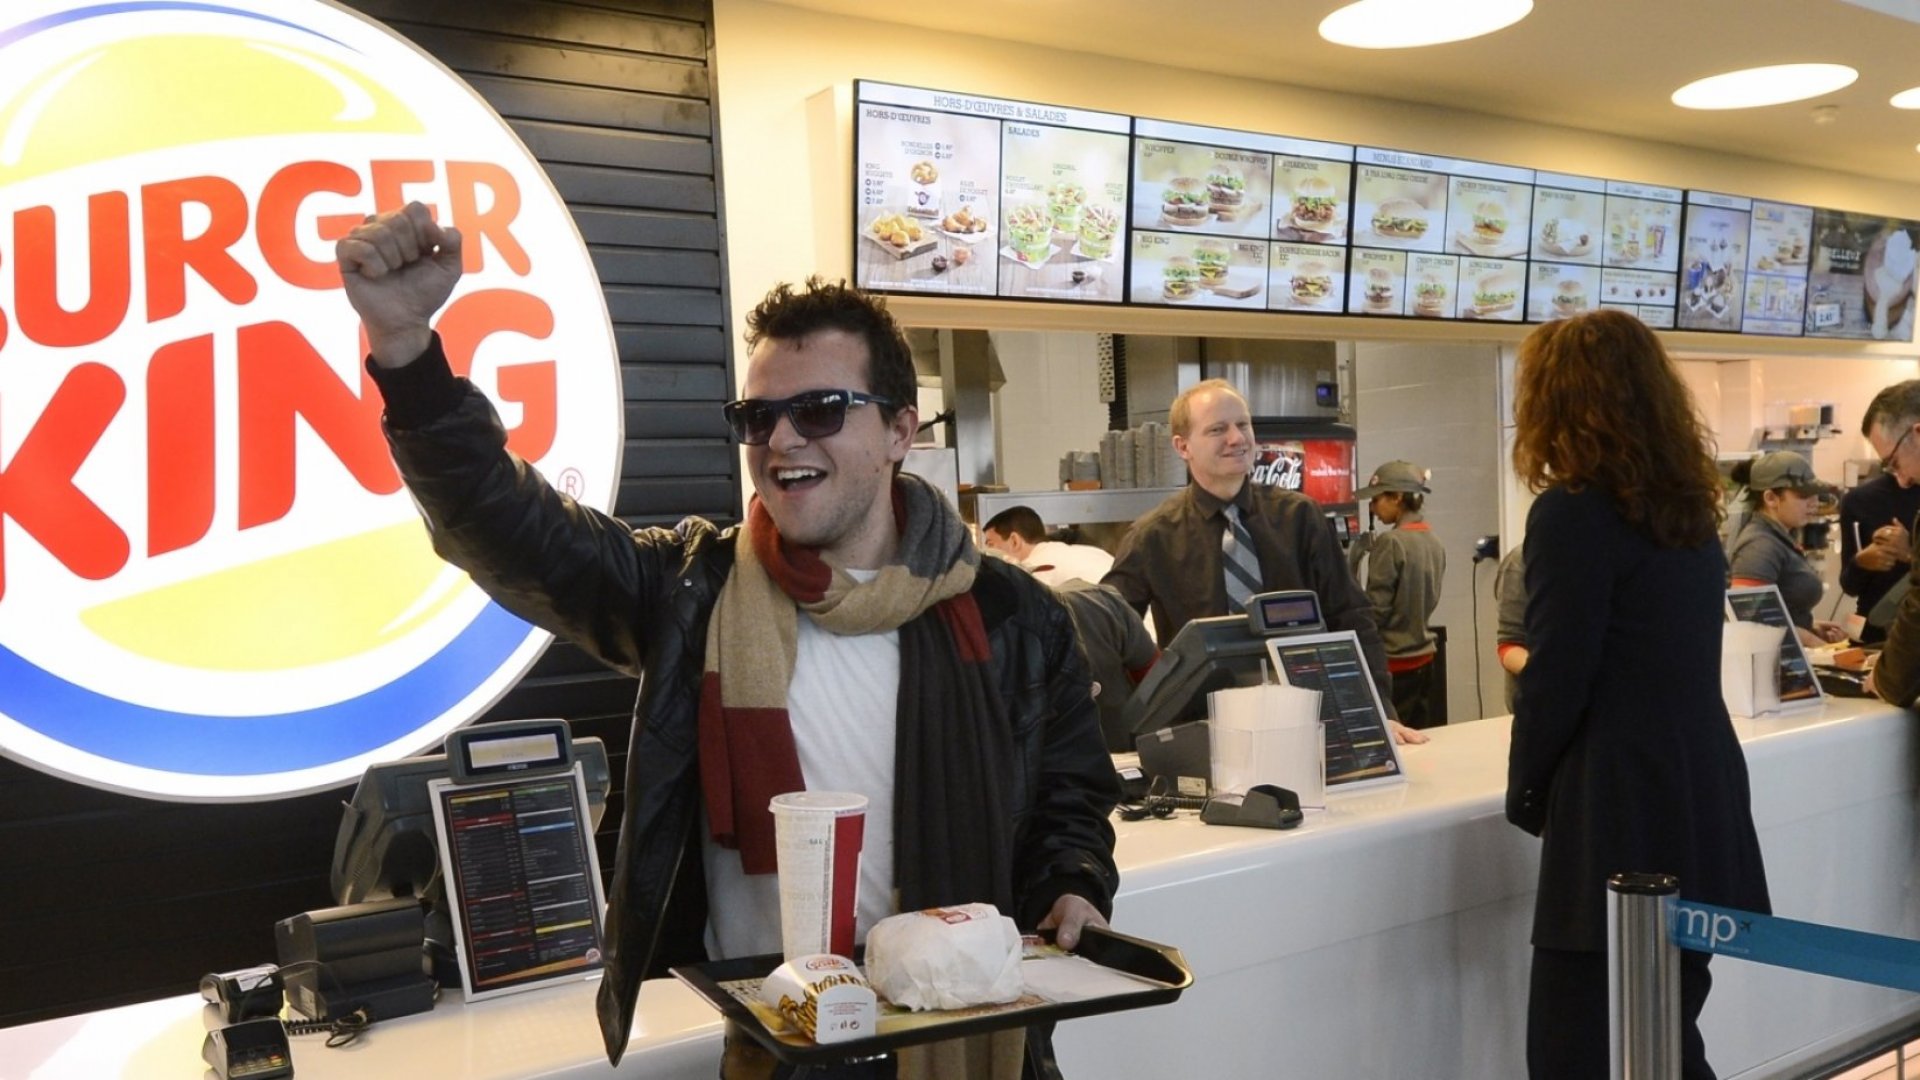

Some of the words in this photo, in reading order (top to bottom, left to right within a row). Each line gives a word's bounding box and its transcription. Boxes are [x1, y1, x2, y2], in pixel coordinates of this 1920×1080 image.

[1008, 125, 1040, 138] SALADES
[1025, 107, 1068, 123] SALADES
[0, 160, 532, 352] URGR
[0, 288, 559, 600] KING
[1249, 452, 1302, 489] a-Cola
